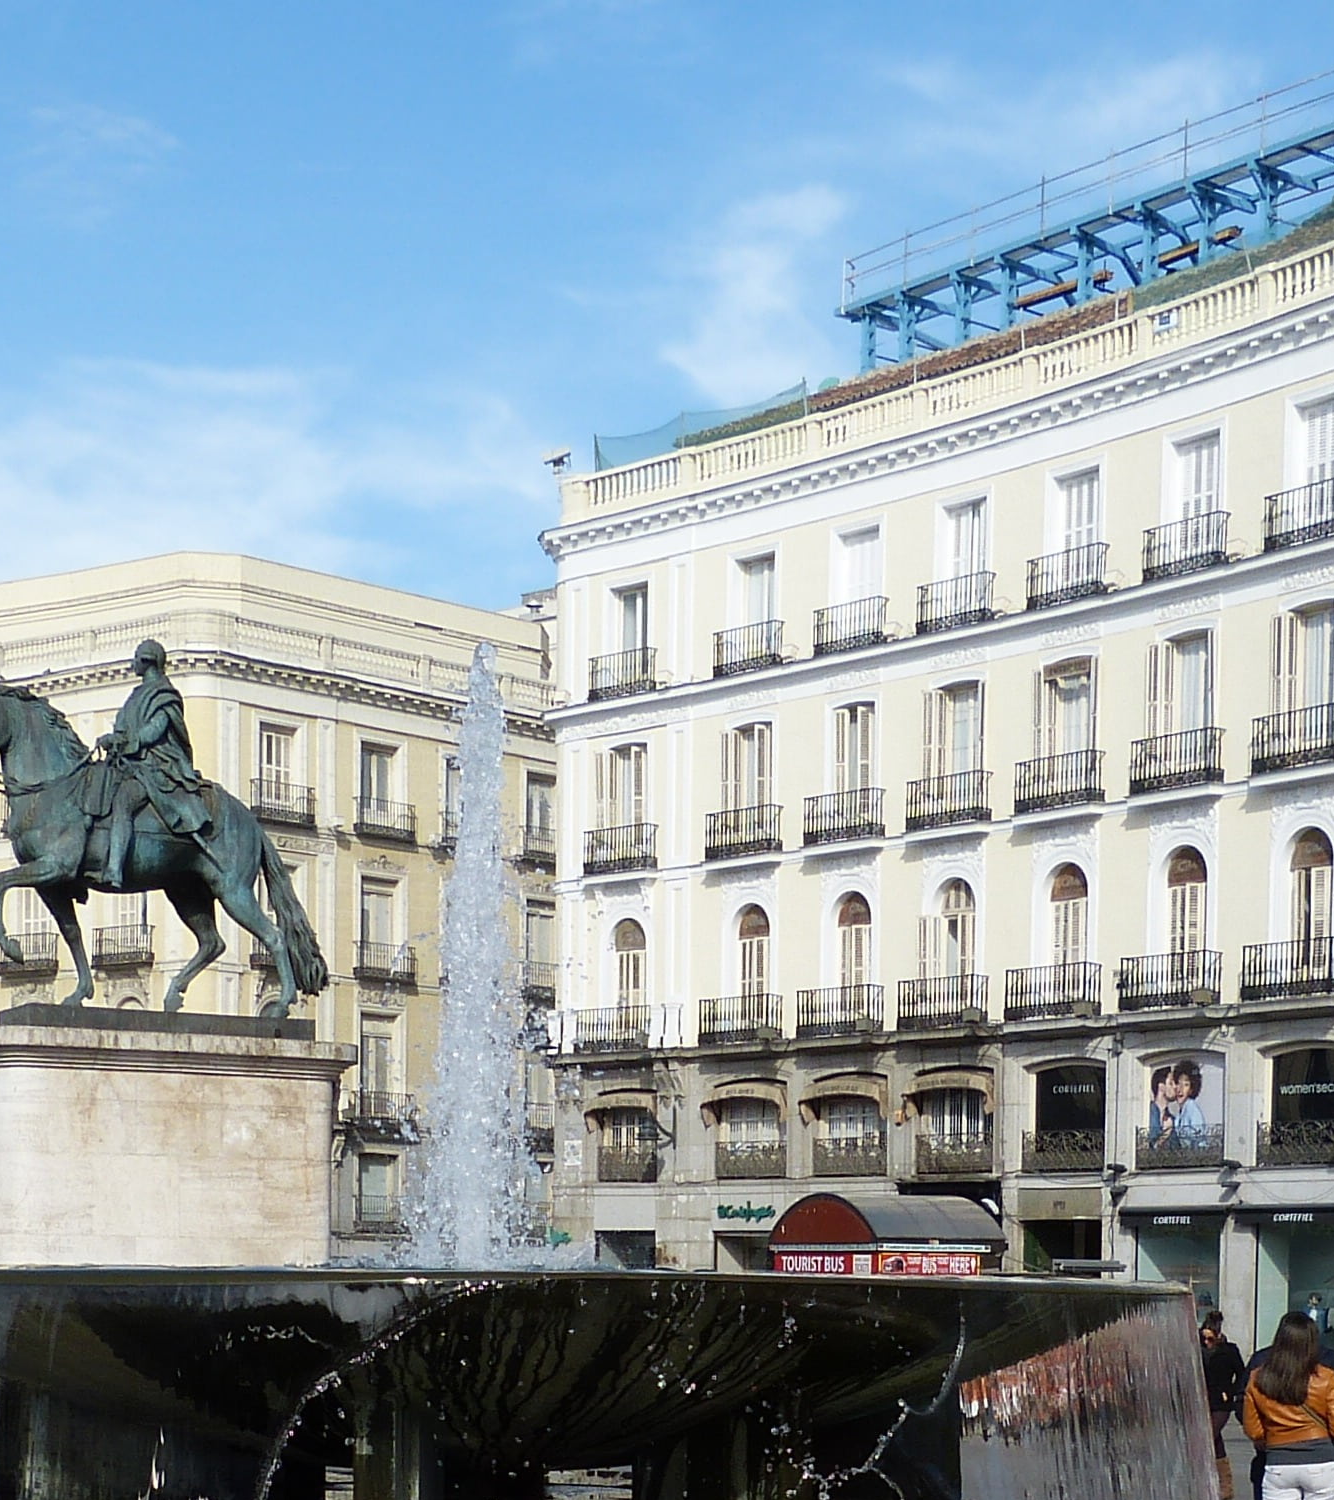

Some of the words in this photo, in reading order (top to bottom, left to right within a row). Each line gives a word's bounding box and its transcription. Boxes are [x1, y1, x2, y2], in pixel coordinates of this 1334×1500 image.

[1153, 1215, 1192, 1225] CORTEFIEL
[1273, 1212, 1315, 1222] CORTEFIEL
[781, 1256, 823, 1273] TOURIST
[824, 1256, 845, 1273] BUS
